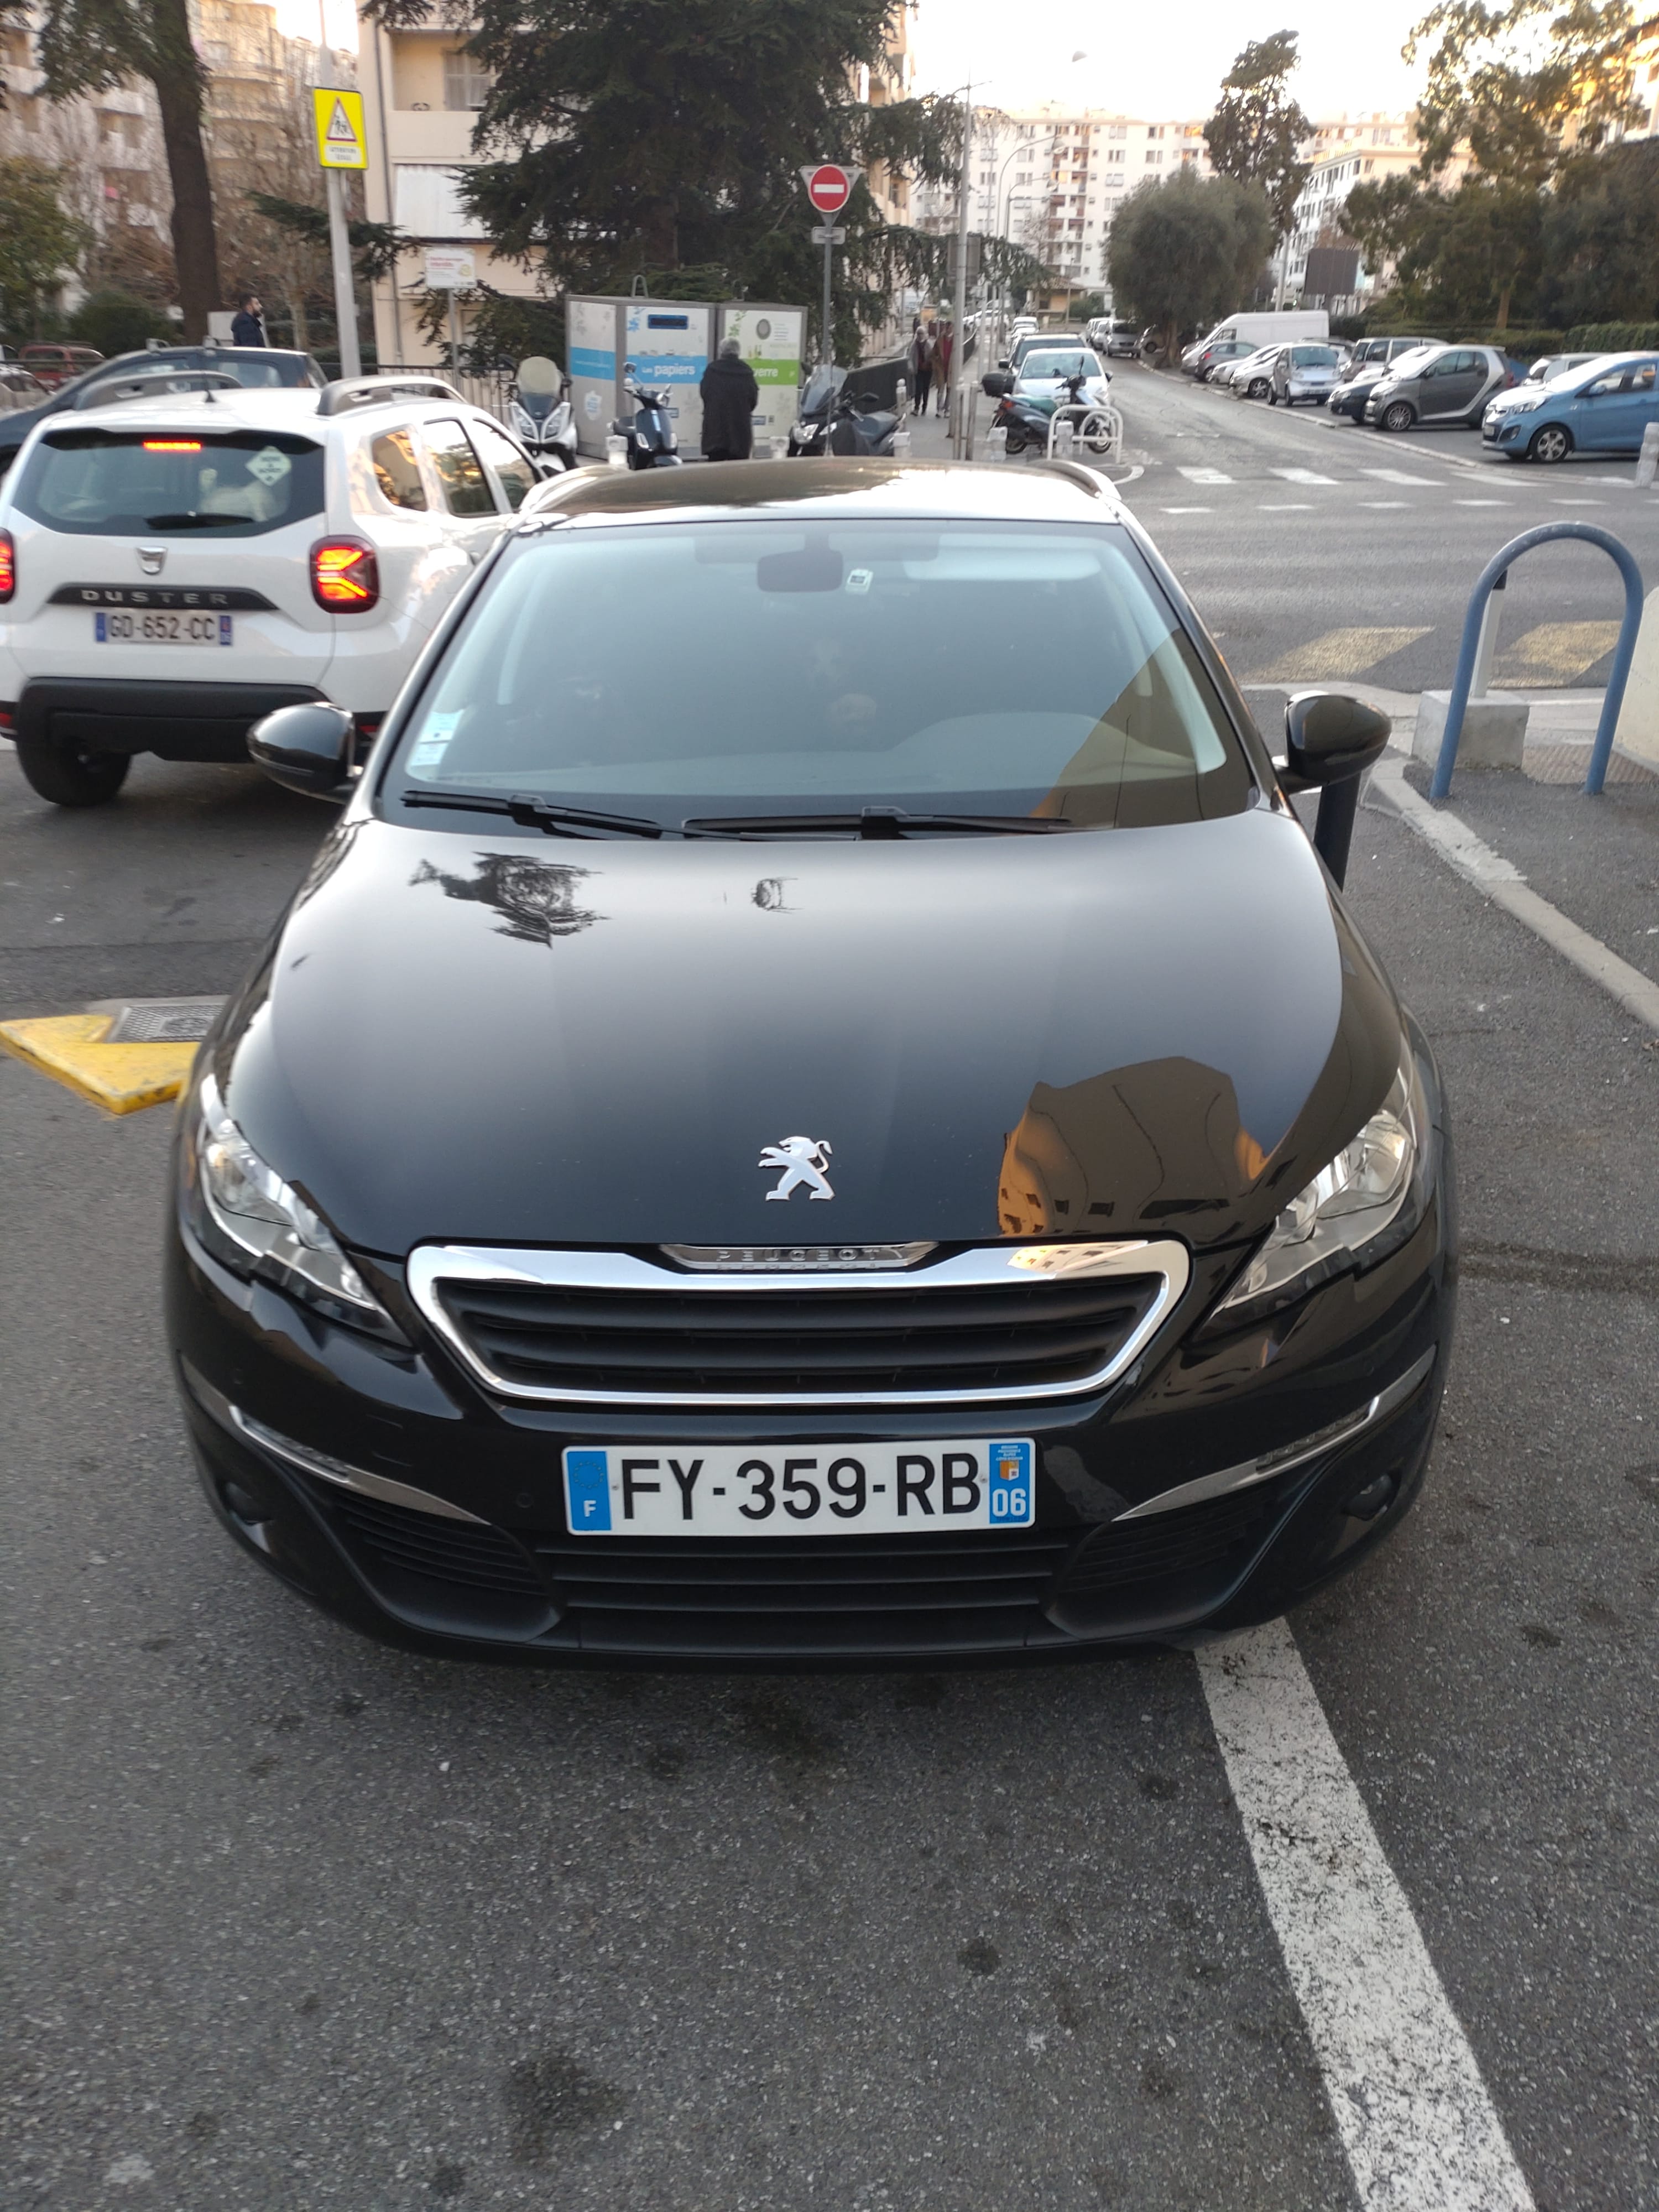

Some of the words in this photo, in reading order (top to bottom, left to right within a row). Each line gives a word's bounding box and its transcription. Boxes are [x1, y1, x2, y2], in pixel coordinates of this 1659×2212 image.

[654, 363, 695, 377] papiers
[81, 589, 228, 604] DUSTER
[110, 615, 215, 640] GD-652-CC
[716, 1248, 883, 1262] PEUGEOT
[583, 1499, 597, 1517] F
[622, 1453, 981, 1520] FY-359-RB
[992, 1488, 1026, 1517] 06
